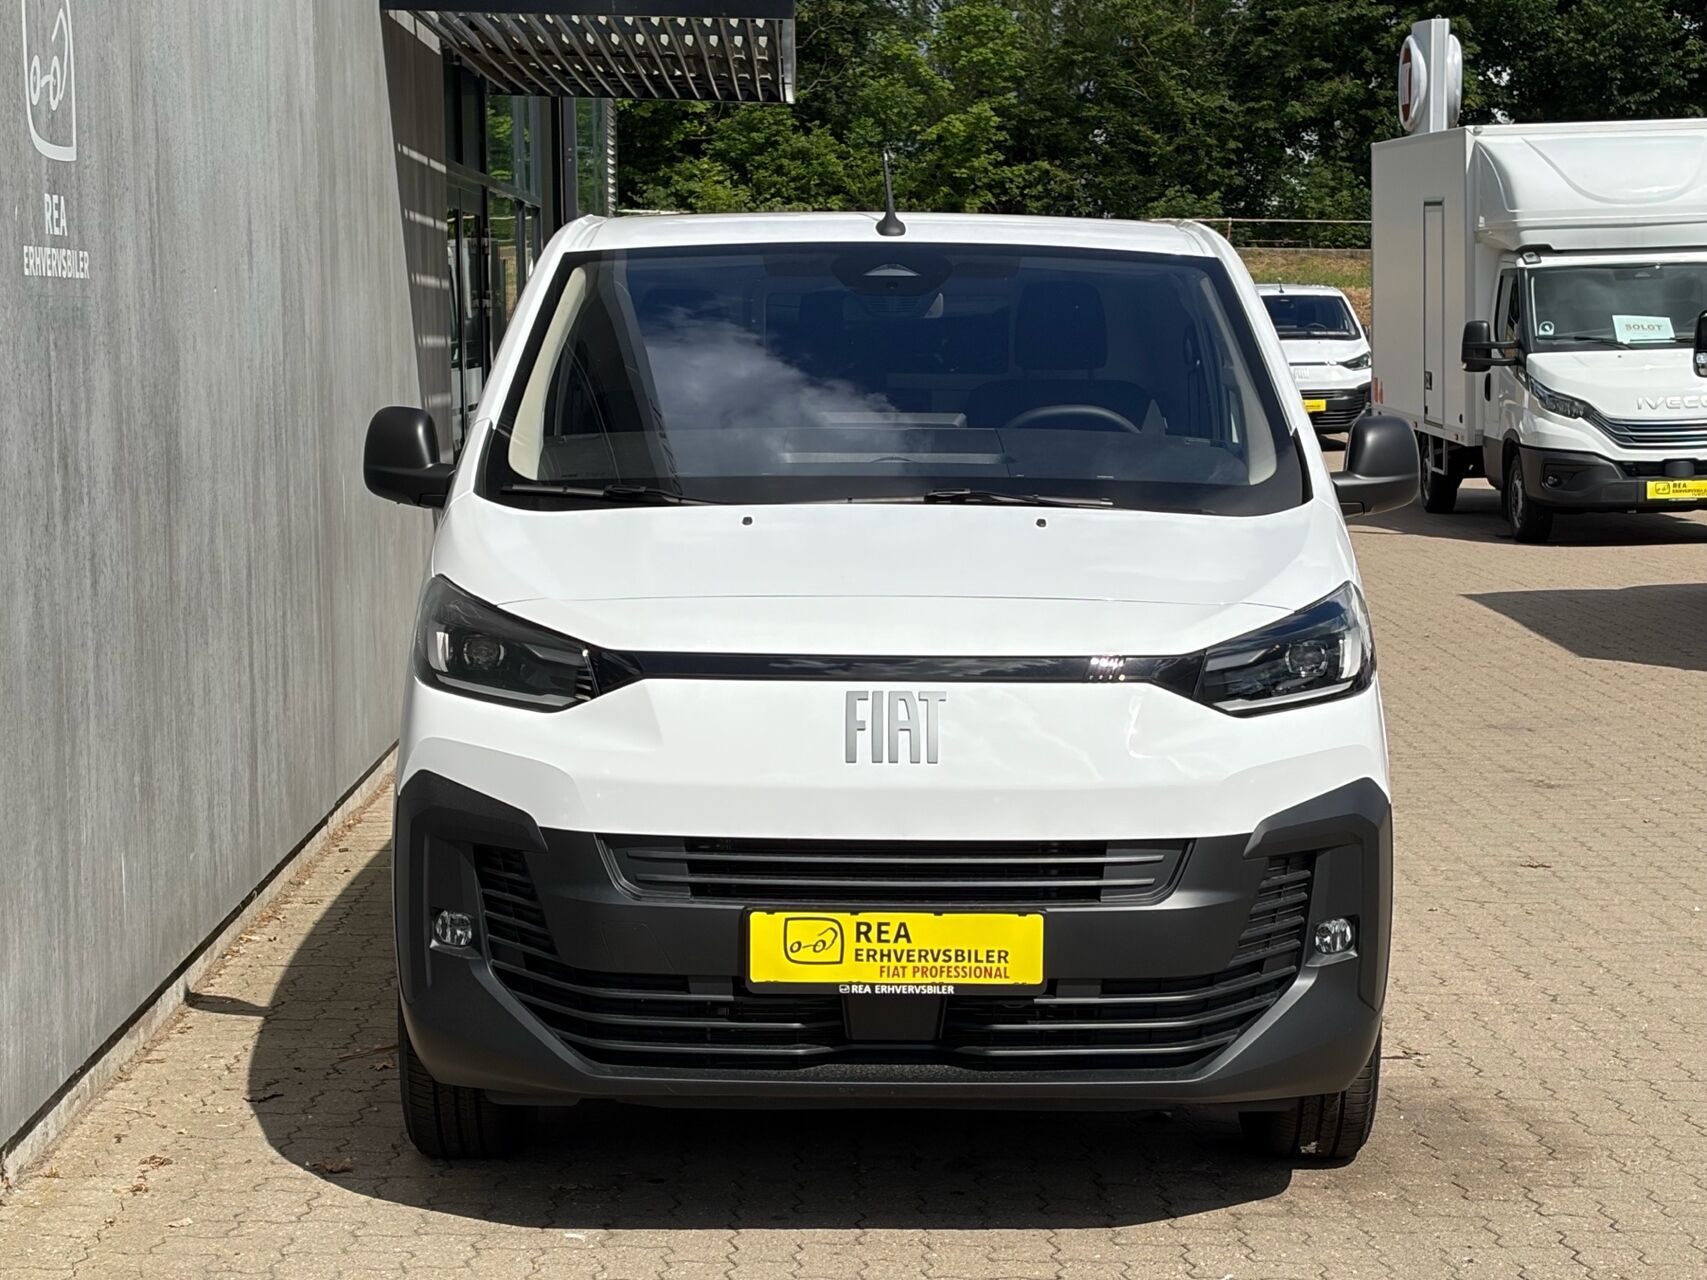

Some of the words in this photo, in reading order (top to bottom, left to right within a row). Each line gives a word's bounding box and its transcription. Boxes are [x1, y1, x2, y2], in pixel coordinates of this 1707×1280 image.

[44, 193, 68, 236] REA
[23, 245, 90, 279] ERHVERVSBILER
[845, 690, 947, 764] FIAT
[855, 921, 912, 944] REA
[854, 948, 1010, 964] ERHVERVSBILER
[879, 965, 908, 979] FIAT
[912, 965, 1010, 980] PROFESSIONAL
[851, 984, 872, 994] REA
[874, 984, 955, 995] ERHVERVSBILER
